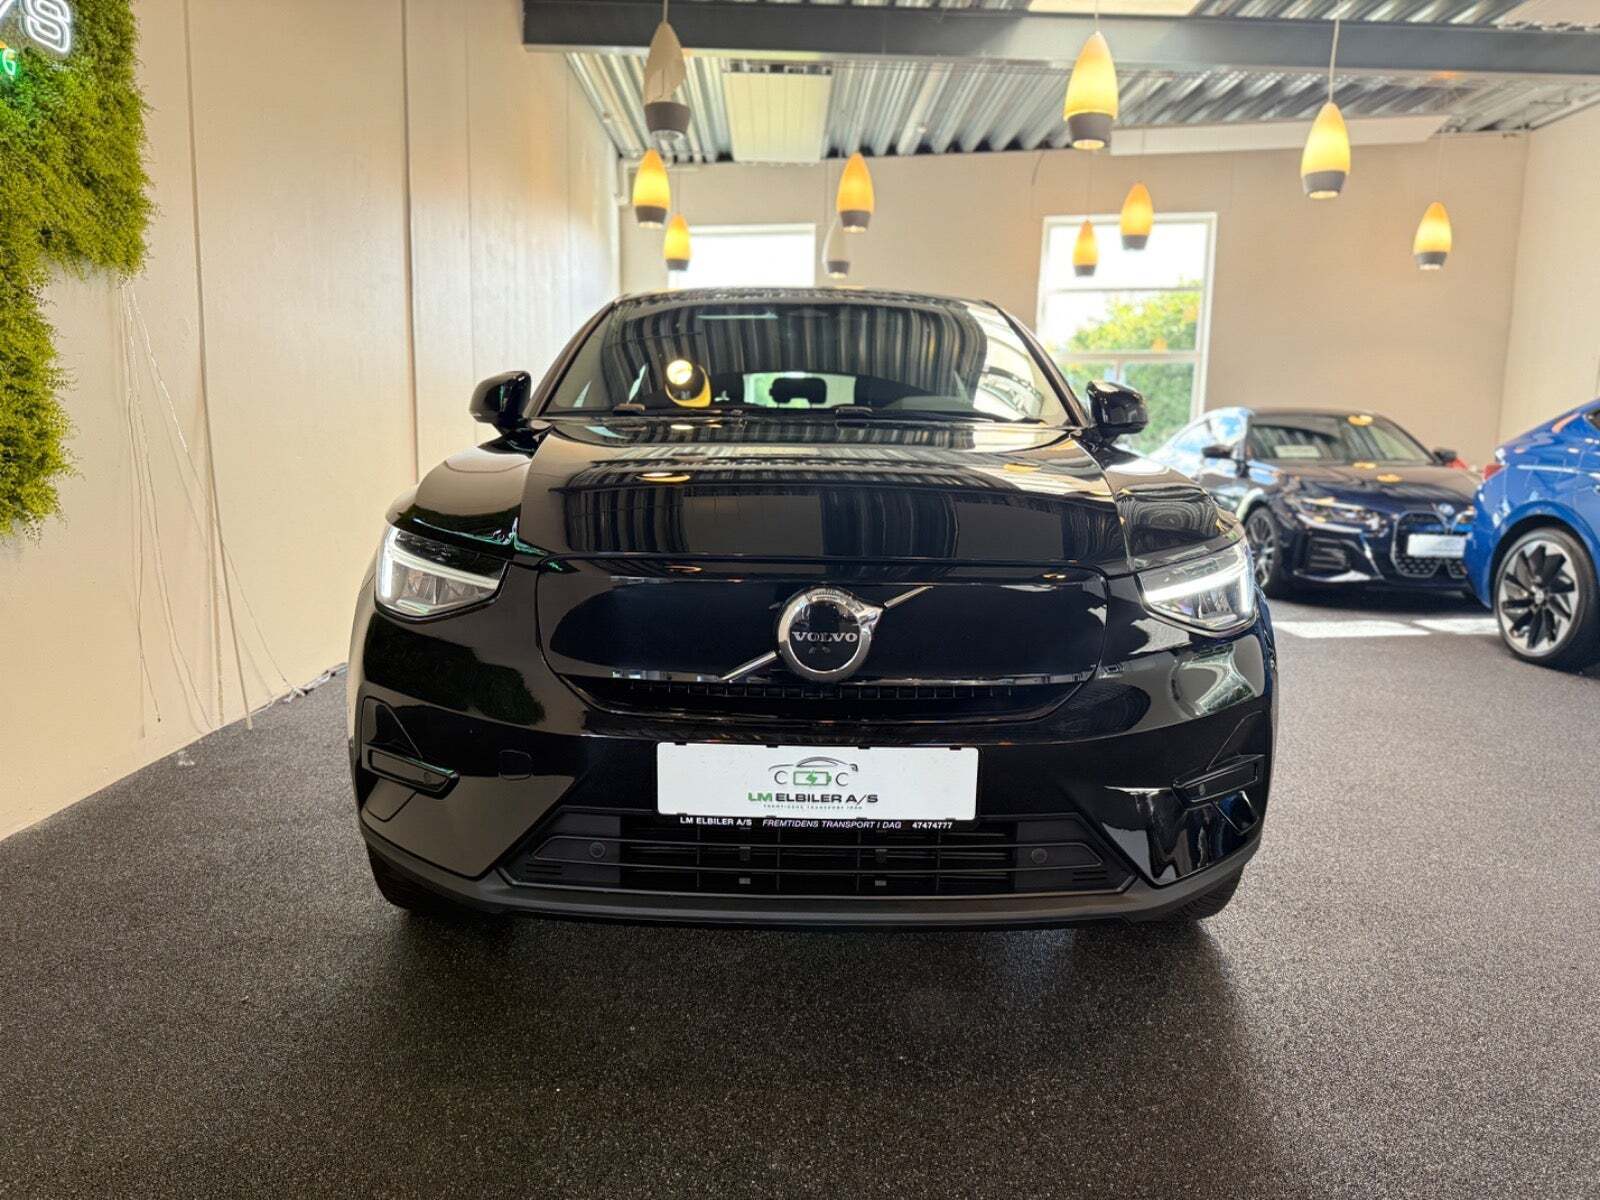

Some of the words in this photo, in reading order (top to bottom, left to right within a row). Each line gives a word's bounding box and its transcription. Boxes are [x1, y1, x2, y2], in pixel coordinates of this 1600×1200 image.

[791, 631, 858, 643] VOLVO
[747, 792, 773, 802] LM
[775, 793, 842, 803] ELBILER
[845, 794, 879, 805] A/S
[680, 816, 693, 824] LM
[696, 817, 734, 826] ELBILER
[736, 818, 752, 826] A/S
[762, 819, 819, 828] FREMTIDENS
[822, 820, 875, 829] TRANSPORT
[882, 821, 902, 829] DAG
[912, 821, 953, 829] 47474777
